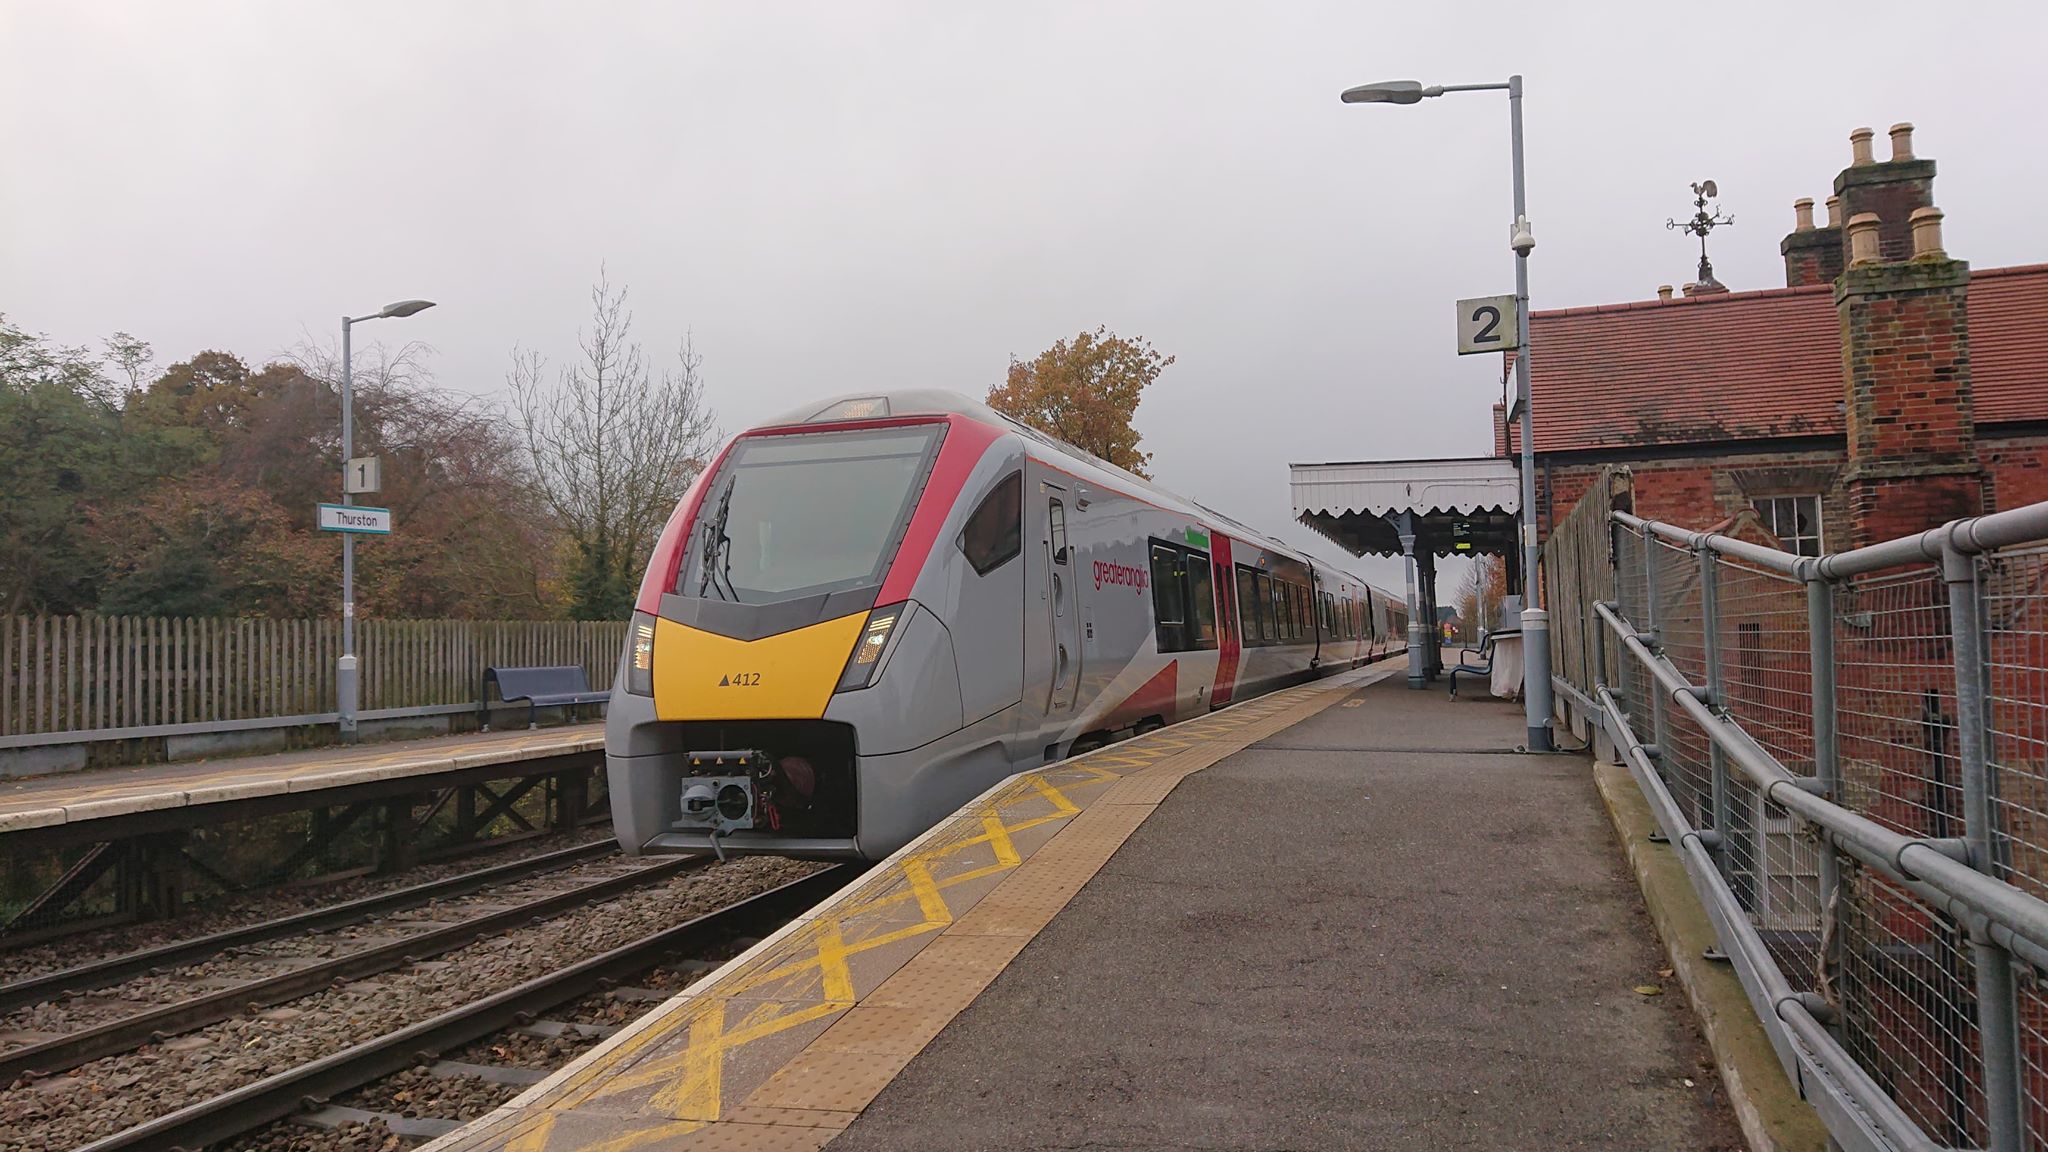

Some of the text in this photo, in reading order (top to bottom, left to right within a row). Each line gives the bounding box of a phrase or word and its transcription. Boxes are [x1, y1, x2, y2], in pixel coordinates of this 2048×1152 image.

[1472, 306, 1500, 343] 2
[358, 464, 365, 488] 1
[336, 511, 378, 527] Thurston
[1093, 559, 1149, 596] greateranglia
[732, 672, 761, 686] 412
